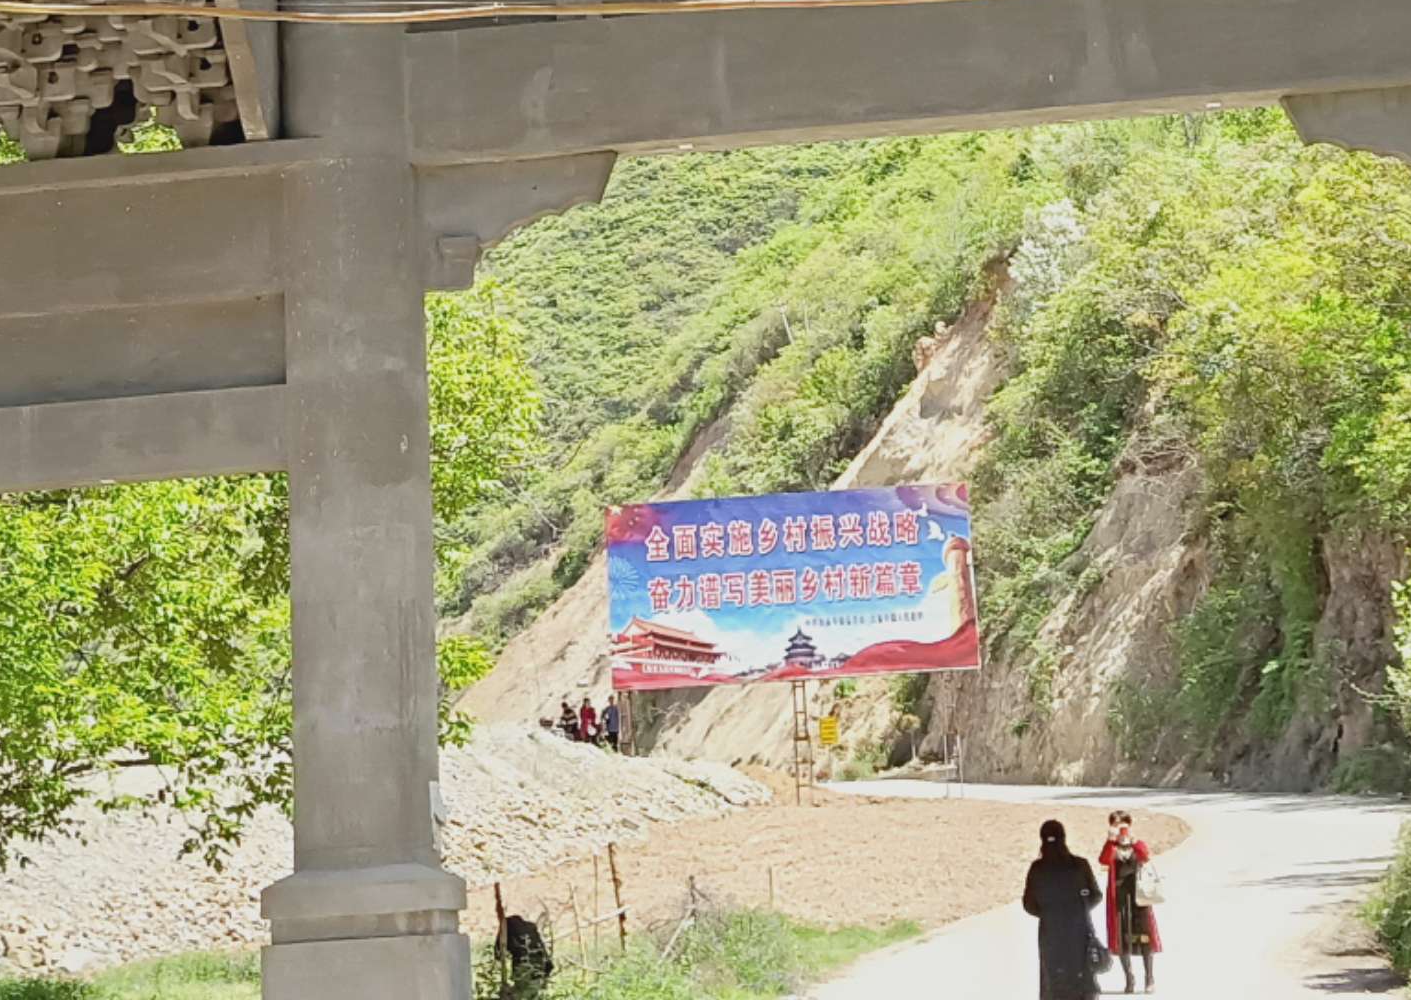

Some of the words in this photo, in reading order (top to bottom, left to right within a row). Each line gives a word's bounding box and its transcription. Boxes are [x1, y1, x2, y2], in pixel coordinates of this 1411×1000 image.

[644, 508, 920, 562] 全面实施乡村振兴战略
[647, 560, 923, 612] 奋力谱写美丽乡村新篇章
